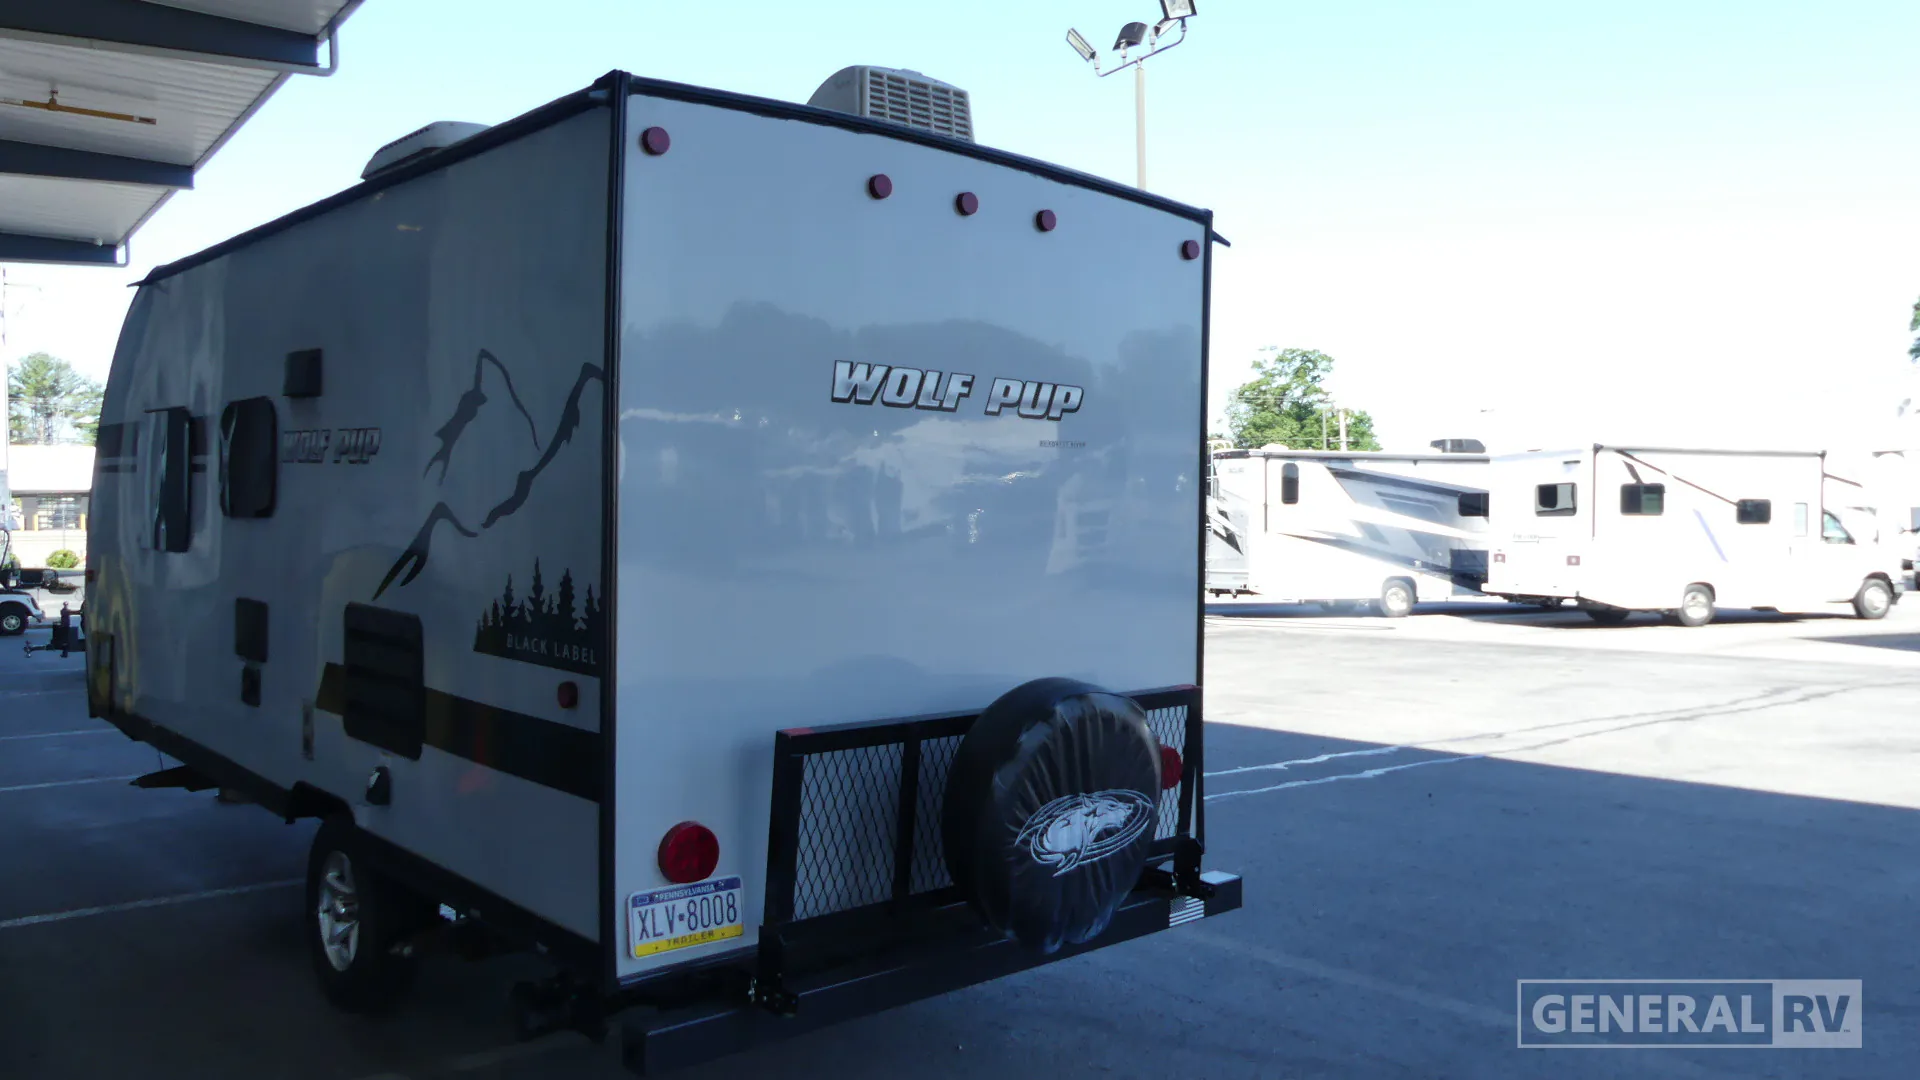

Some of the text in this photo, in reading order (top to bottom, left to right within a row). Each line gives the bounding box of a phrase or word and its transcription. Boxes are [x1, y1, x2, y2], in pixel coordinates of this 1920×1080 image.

[831, 360, 1084, 421] WOLF PUP
[332, 427, 381, 464] PUP
[506, 633, 596, 665] BLACK LABEL
[659, 884, 716, 900] PENNSYLVANIA
